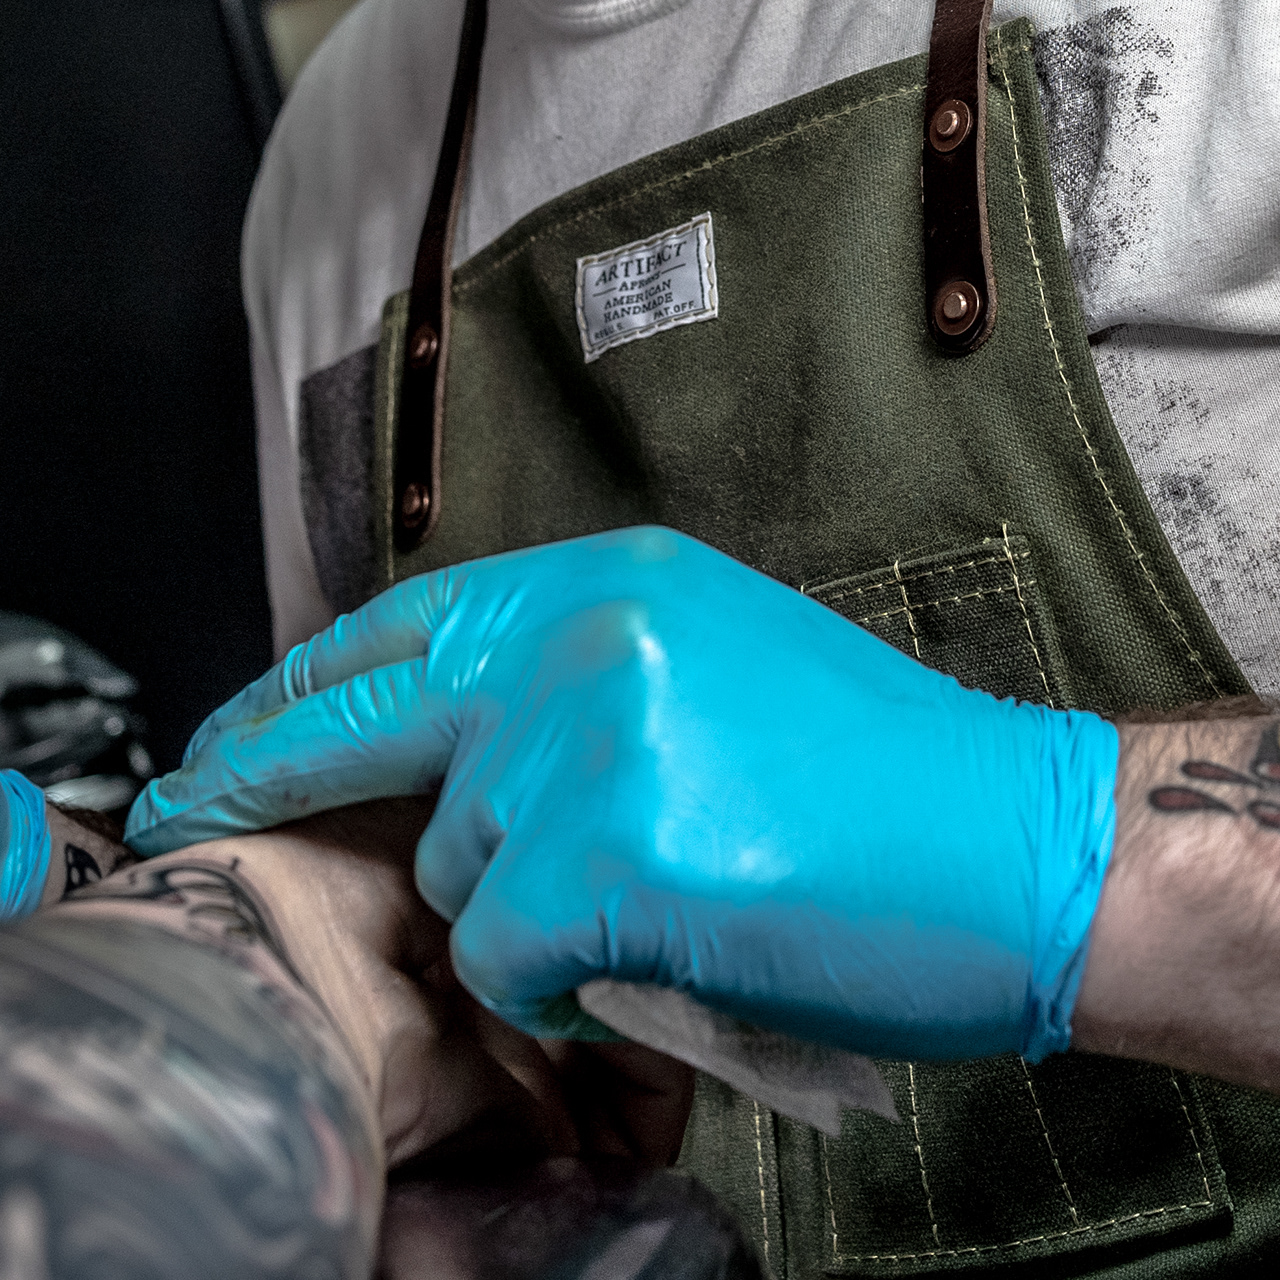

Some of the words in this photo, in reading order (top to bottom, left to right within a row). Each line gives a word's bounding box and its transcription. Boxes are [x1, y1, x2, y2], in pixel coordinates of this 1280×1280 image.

[594, 240, 688, 287] ARTIFACT
[604, 278, 672, 310] AMERICAN
[604, 292, 674, 323] HANDMADE
